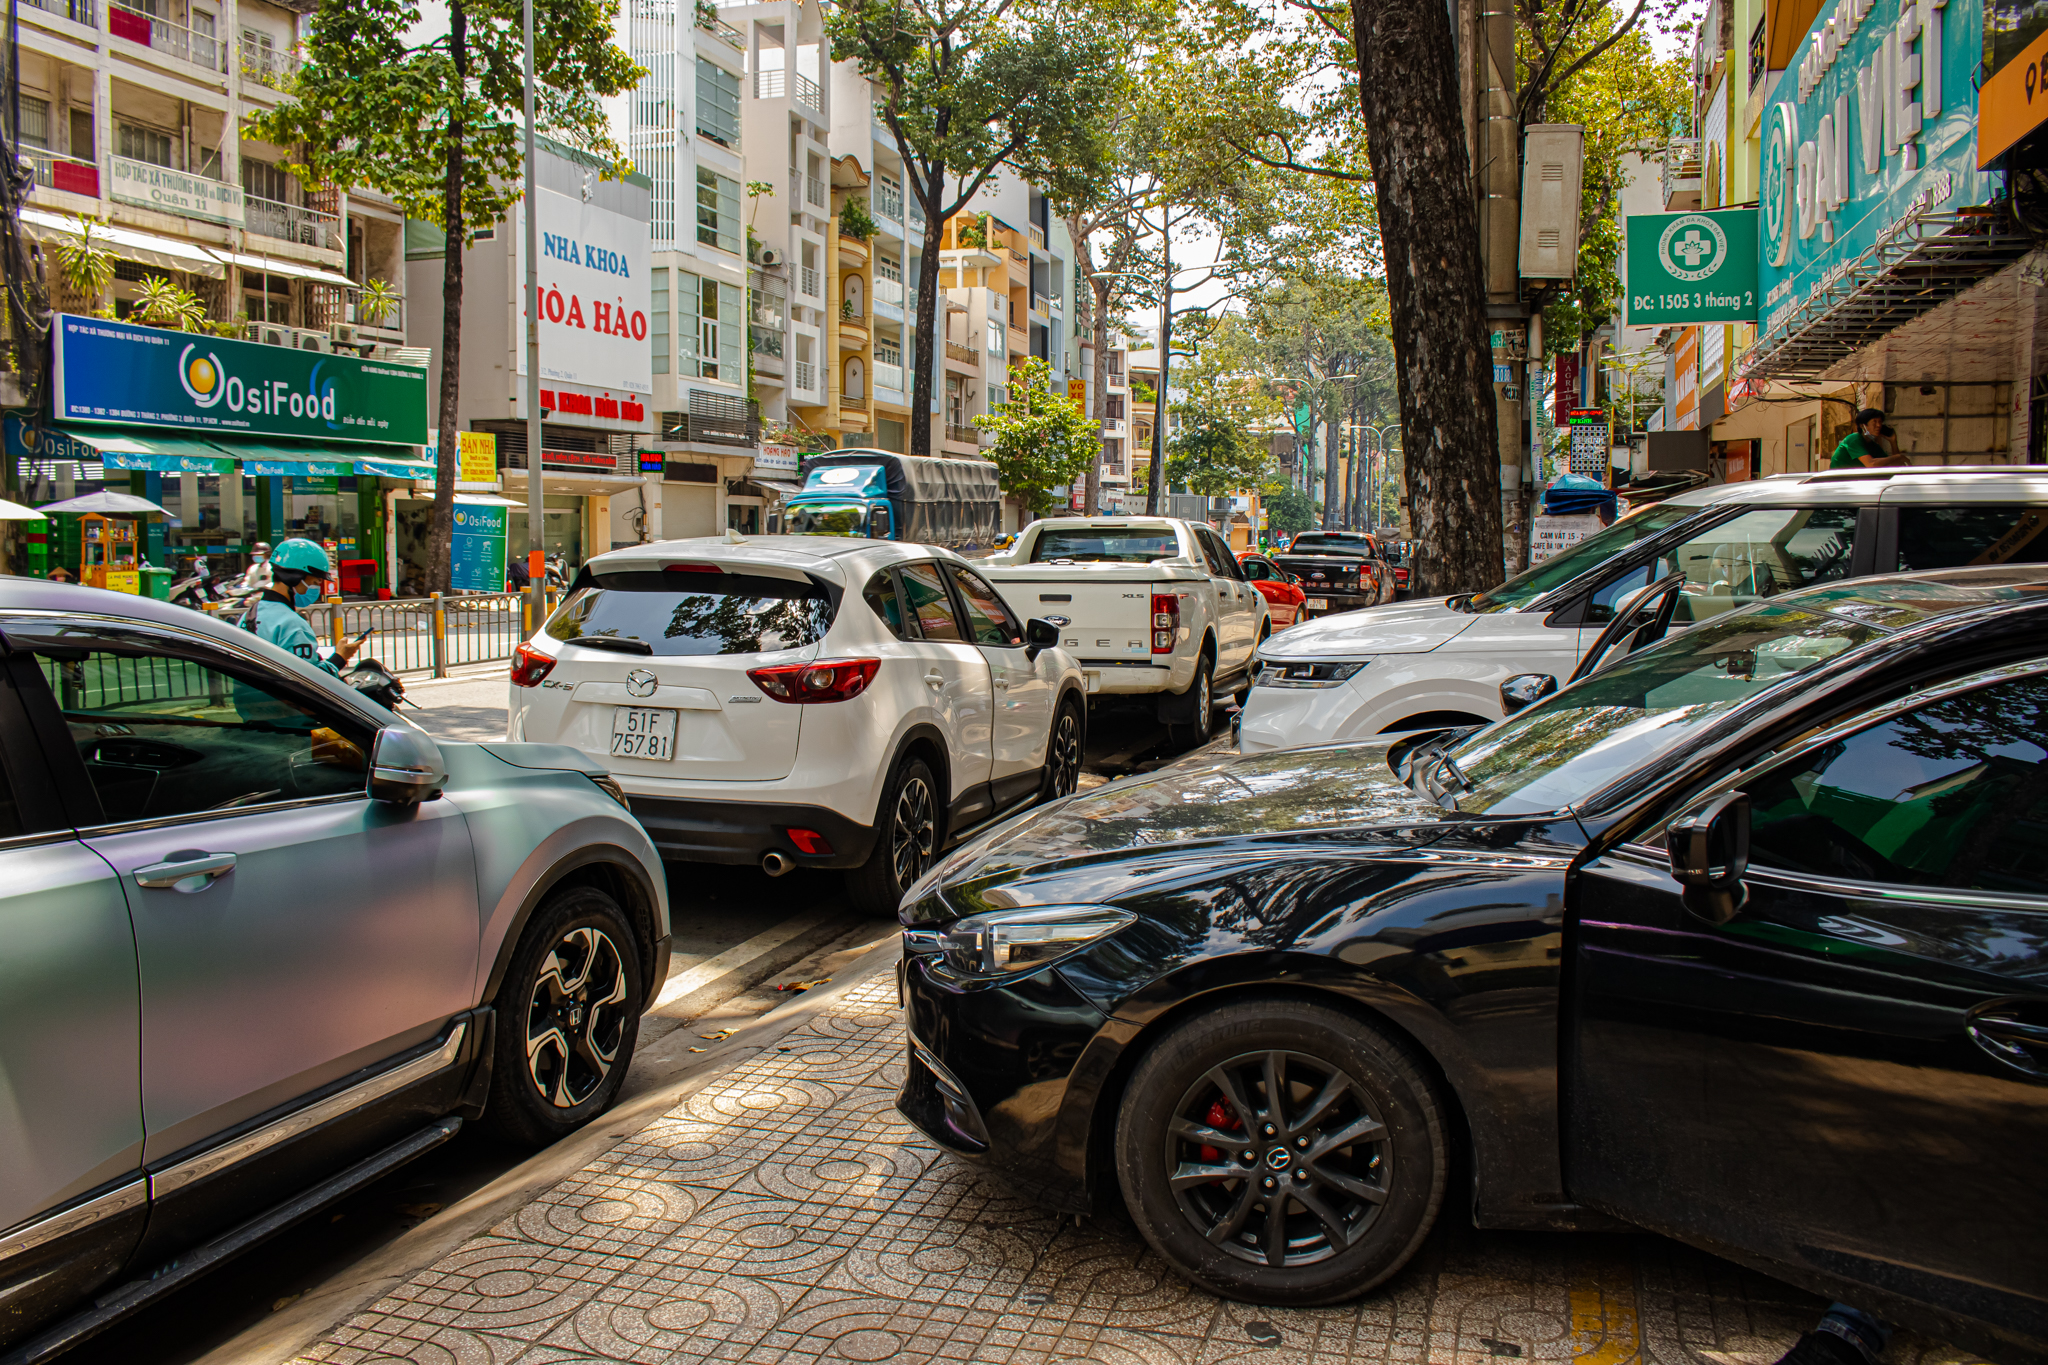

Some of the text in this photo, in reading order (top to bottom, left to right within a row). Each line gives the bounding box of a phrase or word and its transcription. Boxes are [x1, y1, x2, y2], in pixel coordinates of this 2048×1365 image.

[151, 189, 207, 211] Quận 11
[1697, 218, 1714, 230] KHOA
[544, 232, 630, 279] NHA KHOA
[1633, 291, 1753, 311] ĐC: 1505 3 tháng 2
[593, 296, 647, 342] HẢO
[226, 376, 336, 421] OsiFood
[558, 391, 593, 415] KHOA
[595, 392, 619, 419] HÒA
[621, 393, 643, 422] HẢO
[462, 435, 478, 453] BÁN
[469, 514, 502, 528] OsiFood
[1567, 532, 1575, 540] 15
[1064, 638, 1142, 648] GER
[542, 679, 575, 691] CX-5
[627, 712, 661, 734] 51F
[612, 732, 668, 758] 757.81
